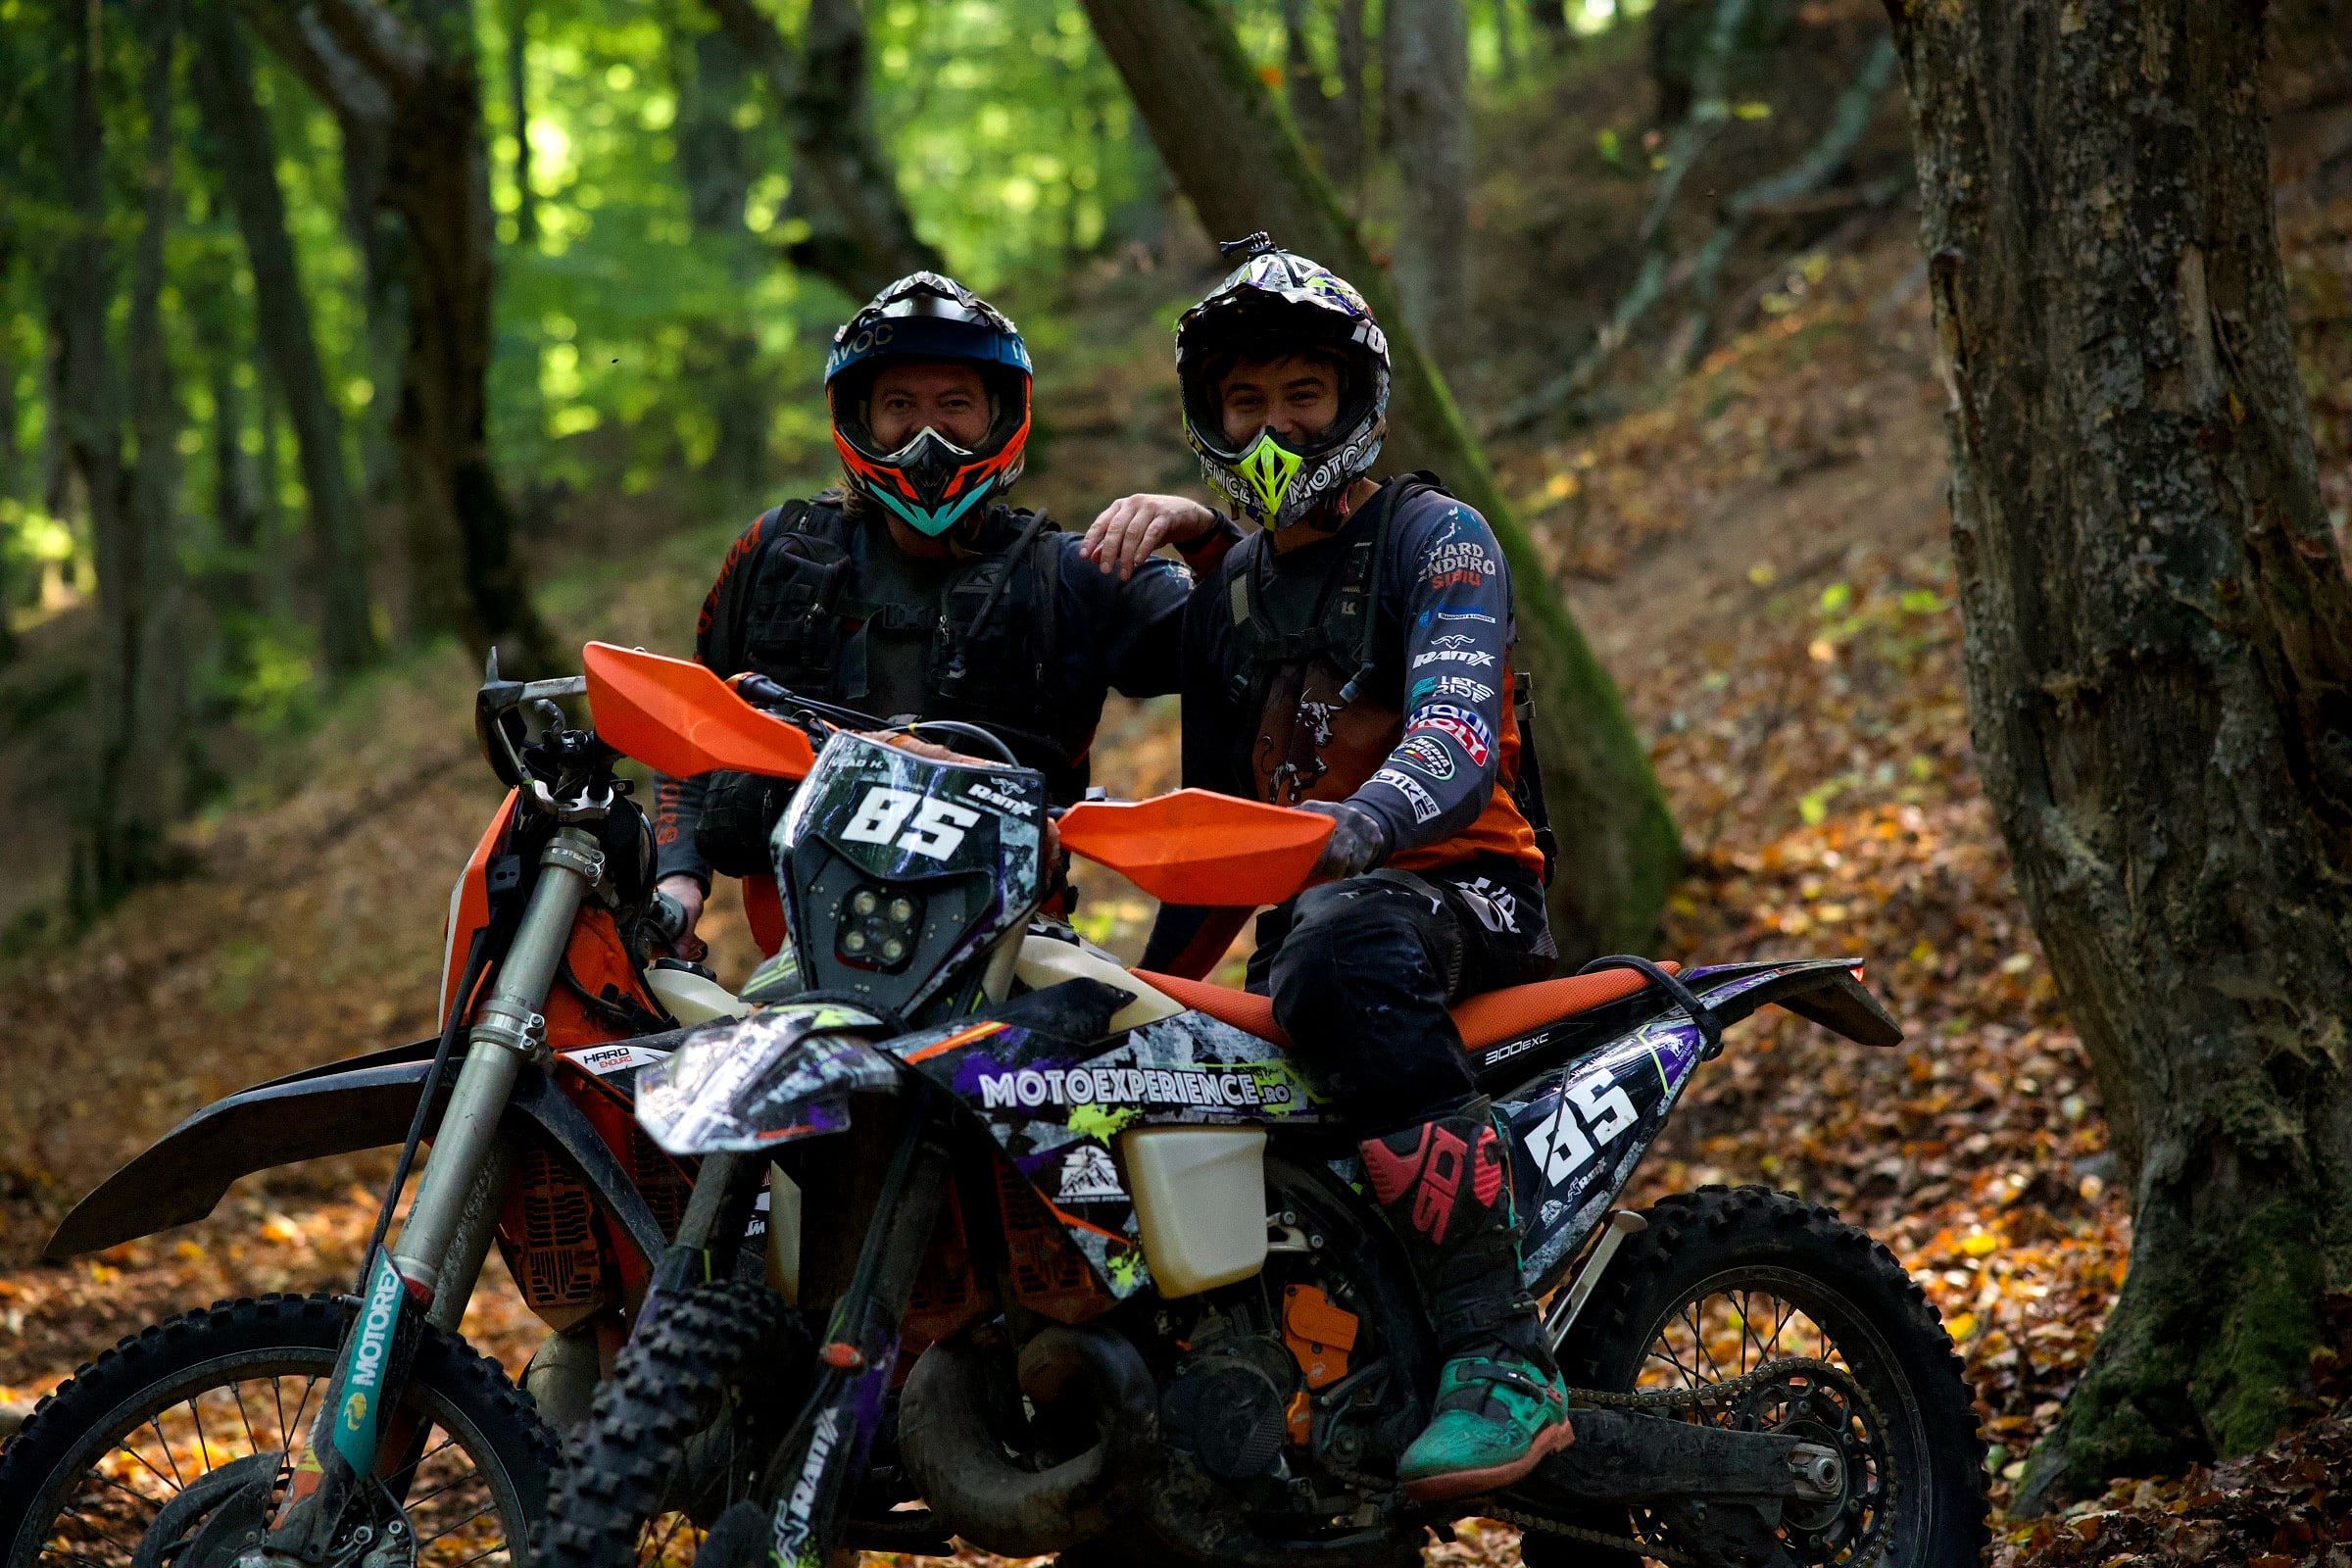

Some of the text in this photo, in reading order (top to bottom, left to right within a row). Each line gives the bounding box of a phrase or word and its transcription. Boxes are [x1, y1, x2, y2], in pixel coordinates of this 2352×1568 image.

[1429, 542, 1485, 561] HARD
[1417, 555, 1496, 582] ENDURO
[1432, 684, 1491, 704] RIDE
[1441, 675, 1494, 696] LETS
[1413, 737, 1450, 767] MEDIA
[840, 785, 981, 862] 85
[583, 1048, 630, 1064] HARD
[599, 1055, 633, 1069] ENDURO
[977, 1066, 1292, 1109] MOTOEXPERIENCE.RO
[1523, 1067, 1640, 1189] 85
[1411, 1125, 1469, 1247] SIDI
